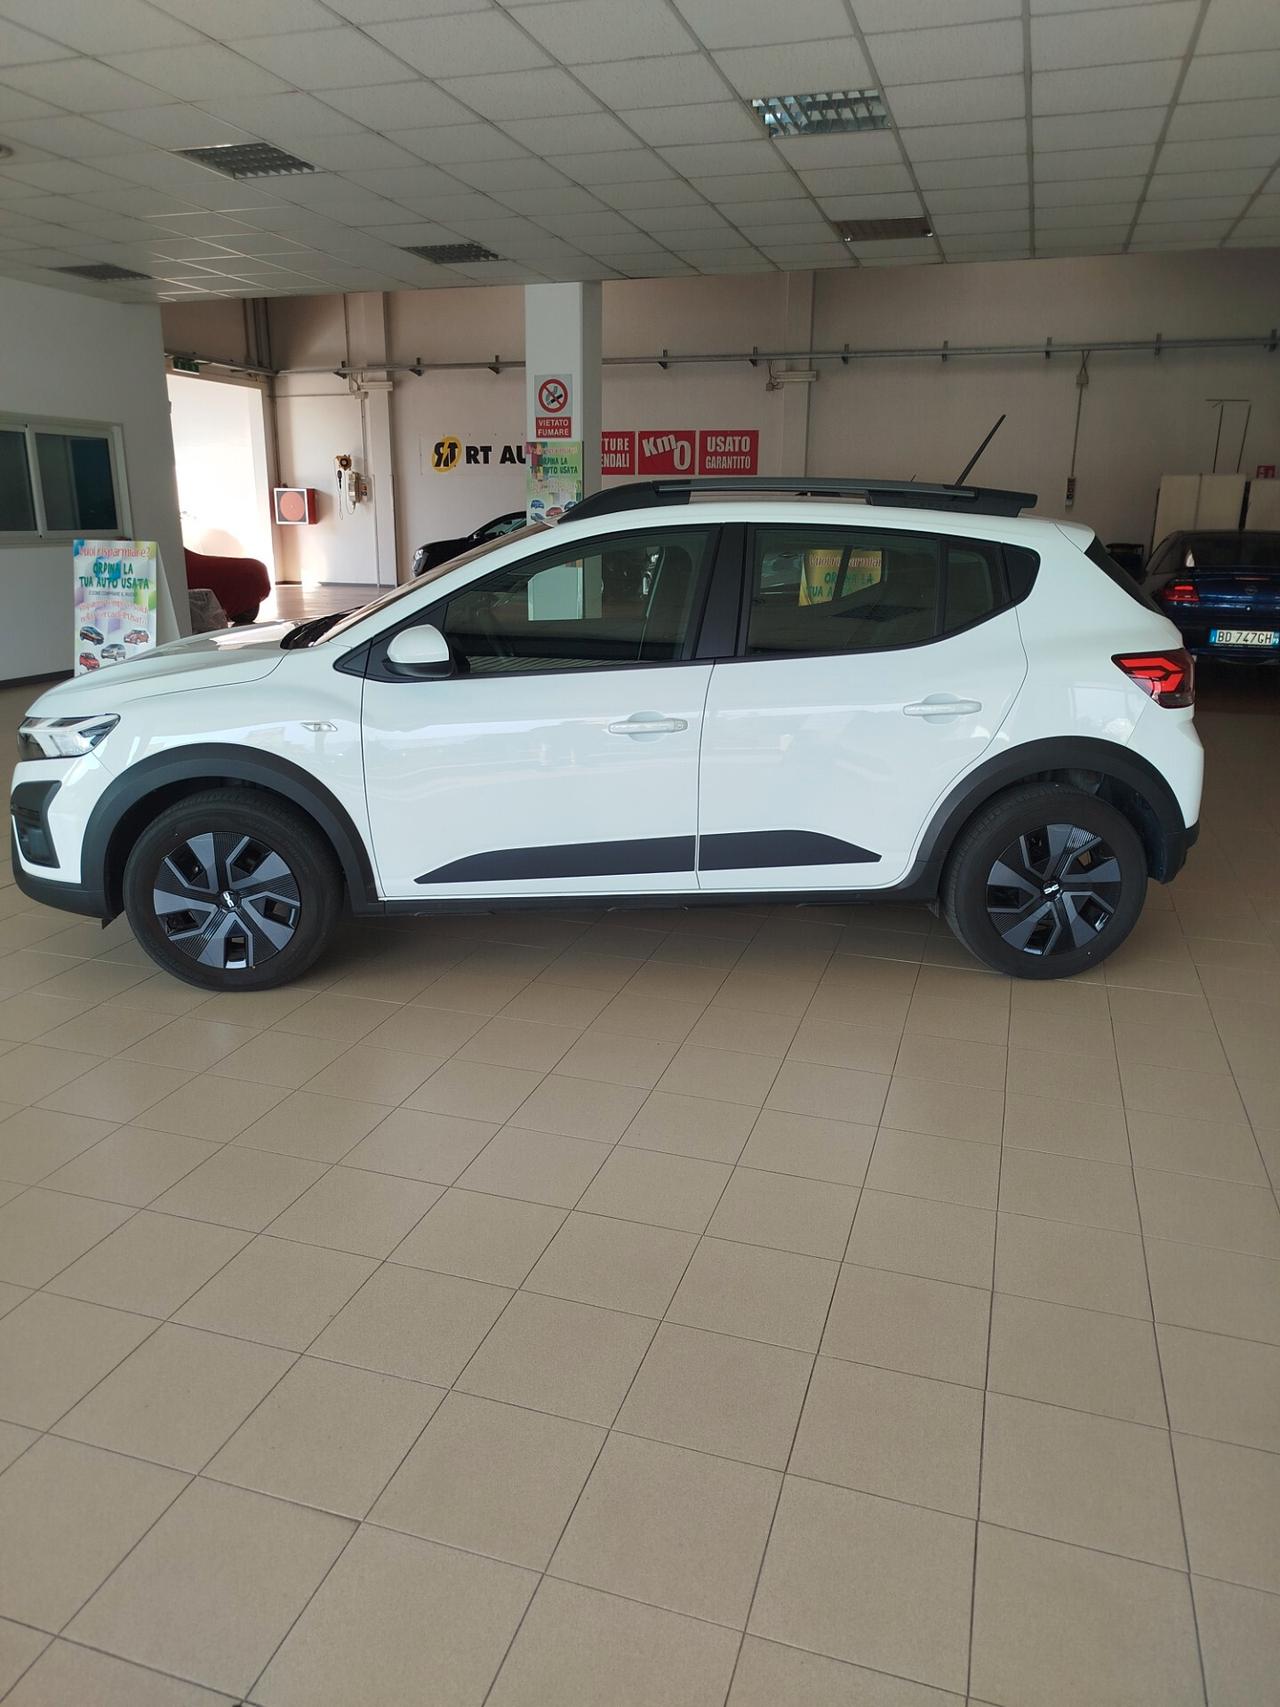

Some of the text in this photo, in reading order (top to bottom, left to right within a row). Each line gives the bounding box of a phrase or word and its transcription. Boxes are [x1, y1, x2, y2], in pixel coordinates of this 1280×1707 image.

[538, 419, 569, 427] VIETATO
[537, 428, 569, 436] FUMARE
[707, 436, 750, 452] USATO
[465, 445, 492, 464] RT
[705, 456, 750, 469] GARANTITO
[123, 563, 134, 575] LA
[79, 576, 150, 589] TUA AUTO USATA
[1217, 631, 1232, 642] BD
[1236, 632, 1272, 644] 747GH
